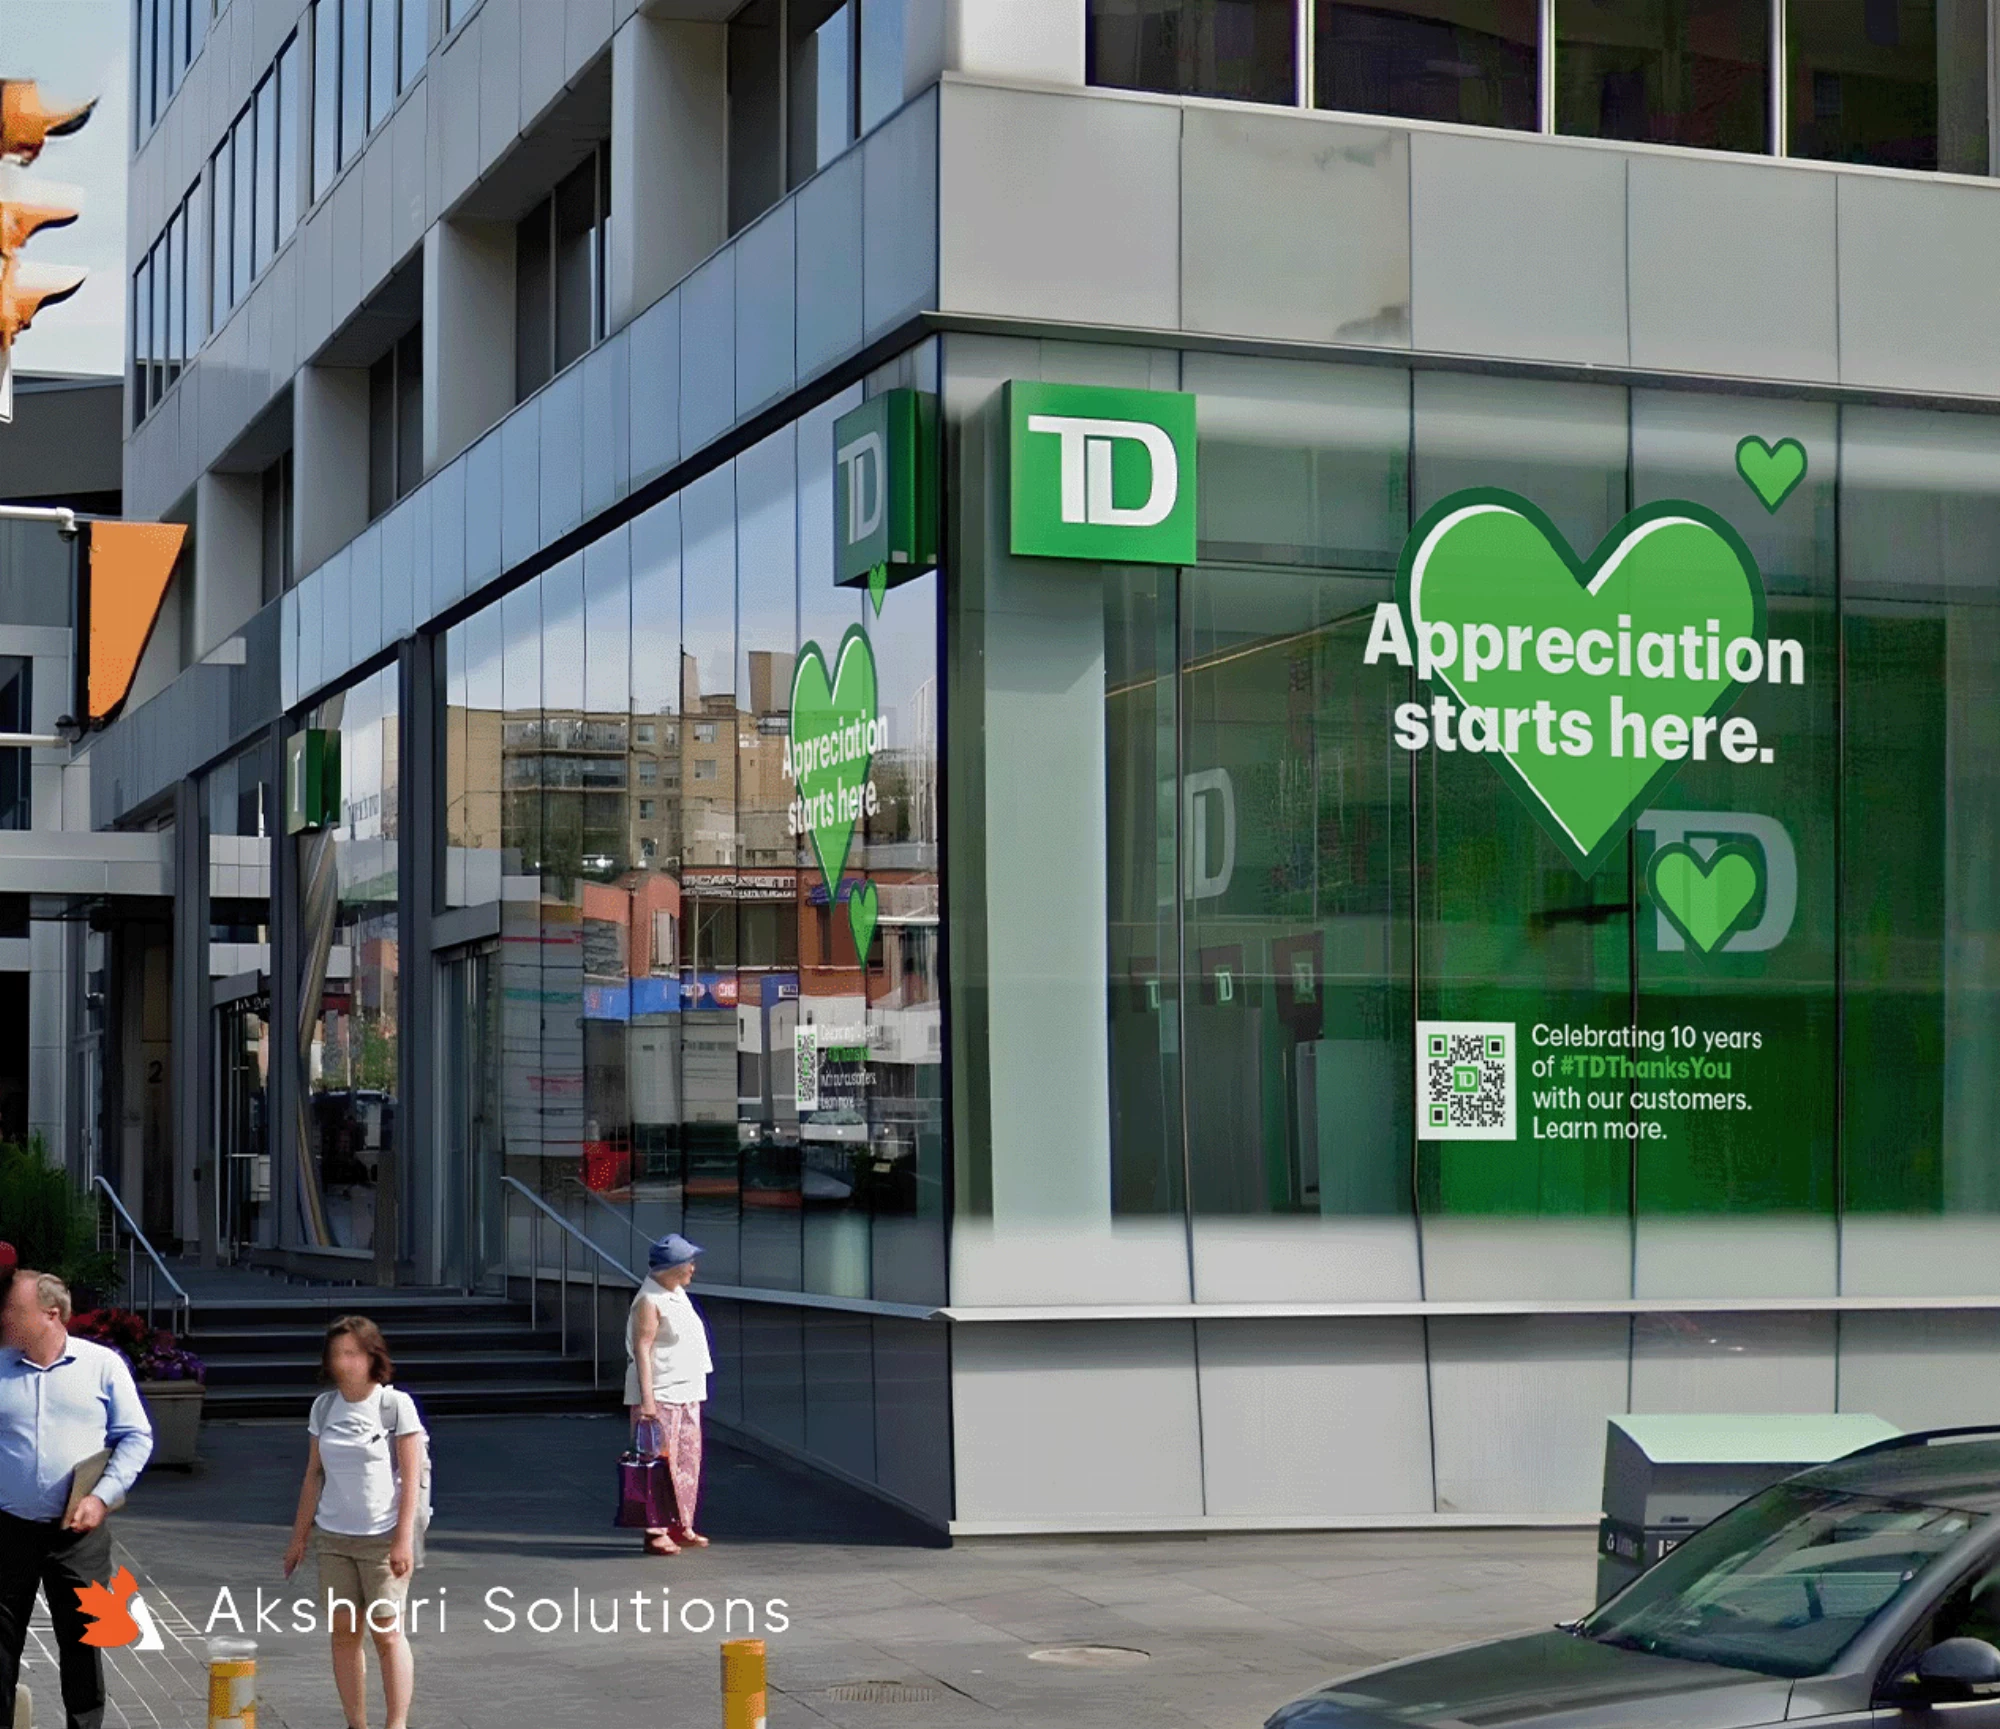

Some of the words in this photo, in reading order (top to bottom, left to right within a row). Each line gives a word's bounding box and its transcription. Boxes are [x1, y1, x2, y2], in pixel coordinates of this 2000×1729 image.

[837, 431, 882, 546] TD
[1028, 415, 1178, 527] TD
[1363, 602, 1805, 684] Appreciation
[781, 708, 888, 787] Appreciation
[1394, 696, 1593, 757] starts
[1610, 695, 1774, 763] here.
[788, 788, 834, 836] starts
[838, 777, 880, 819] here.
[1532, 1023, 1665, 1052] Celebrating
[1670, 1025, 1697, 1049] 10
[1703, 1030, 1763, 1053] years
[1532, 1055, 1555, 1078] of
[1560, 1055, 1732, 1080] #TDThanksYou
[147, 1059, 163, 1084] 2
[1532, 1086, 1581, 1109] with
[1587, 1091, 1624, 1109] our
[1630, 1088, 1753, 1110] customers.
[1533, 1116, 1598, 1140] Learn
[1603, 1121, 1668, 1140] more.
